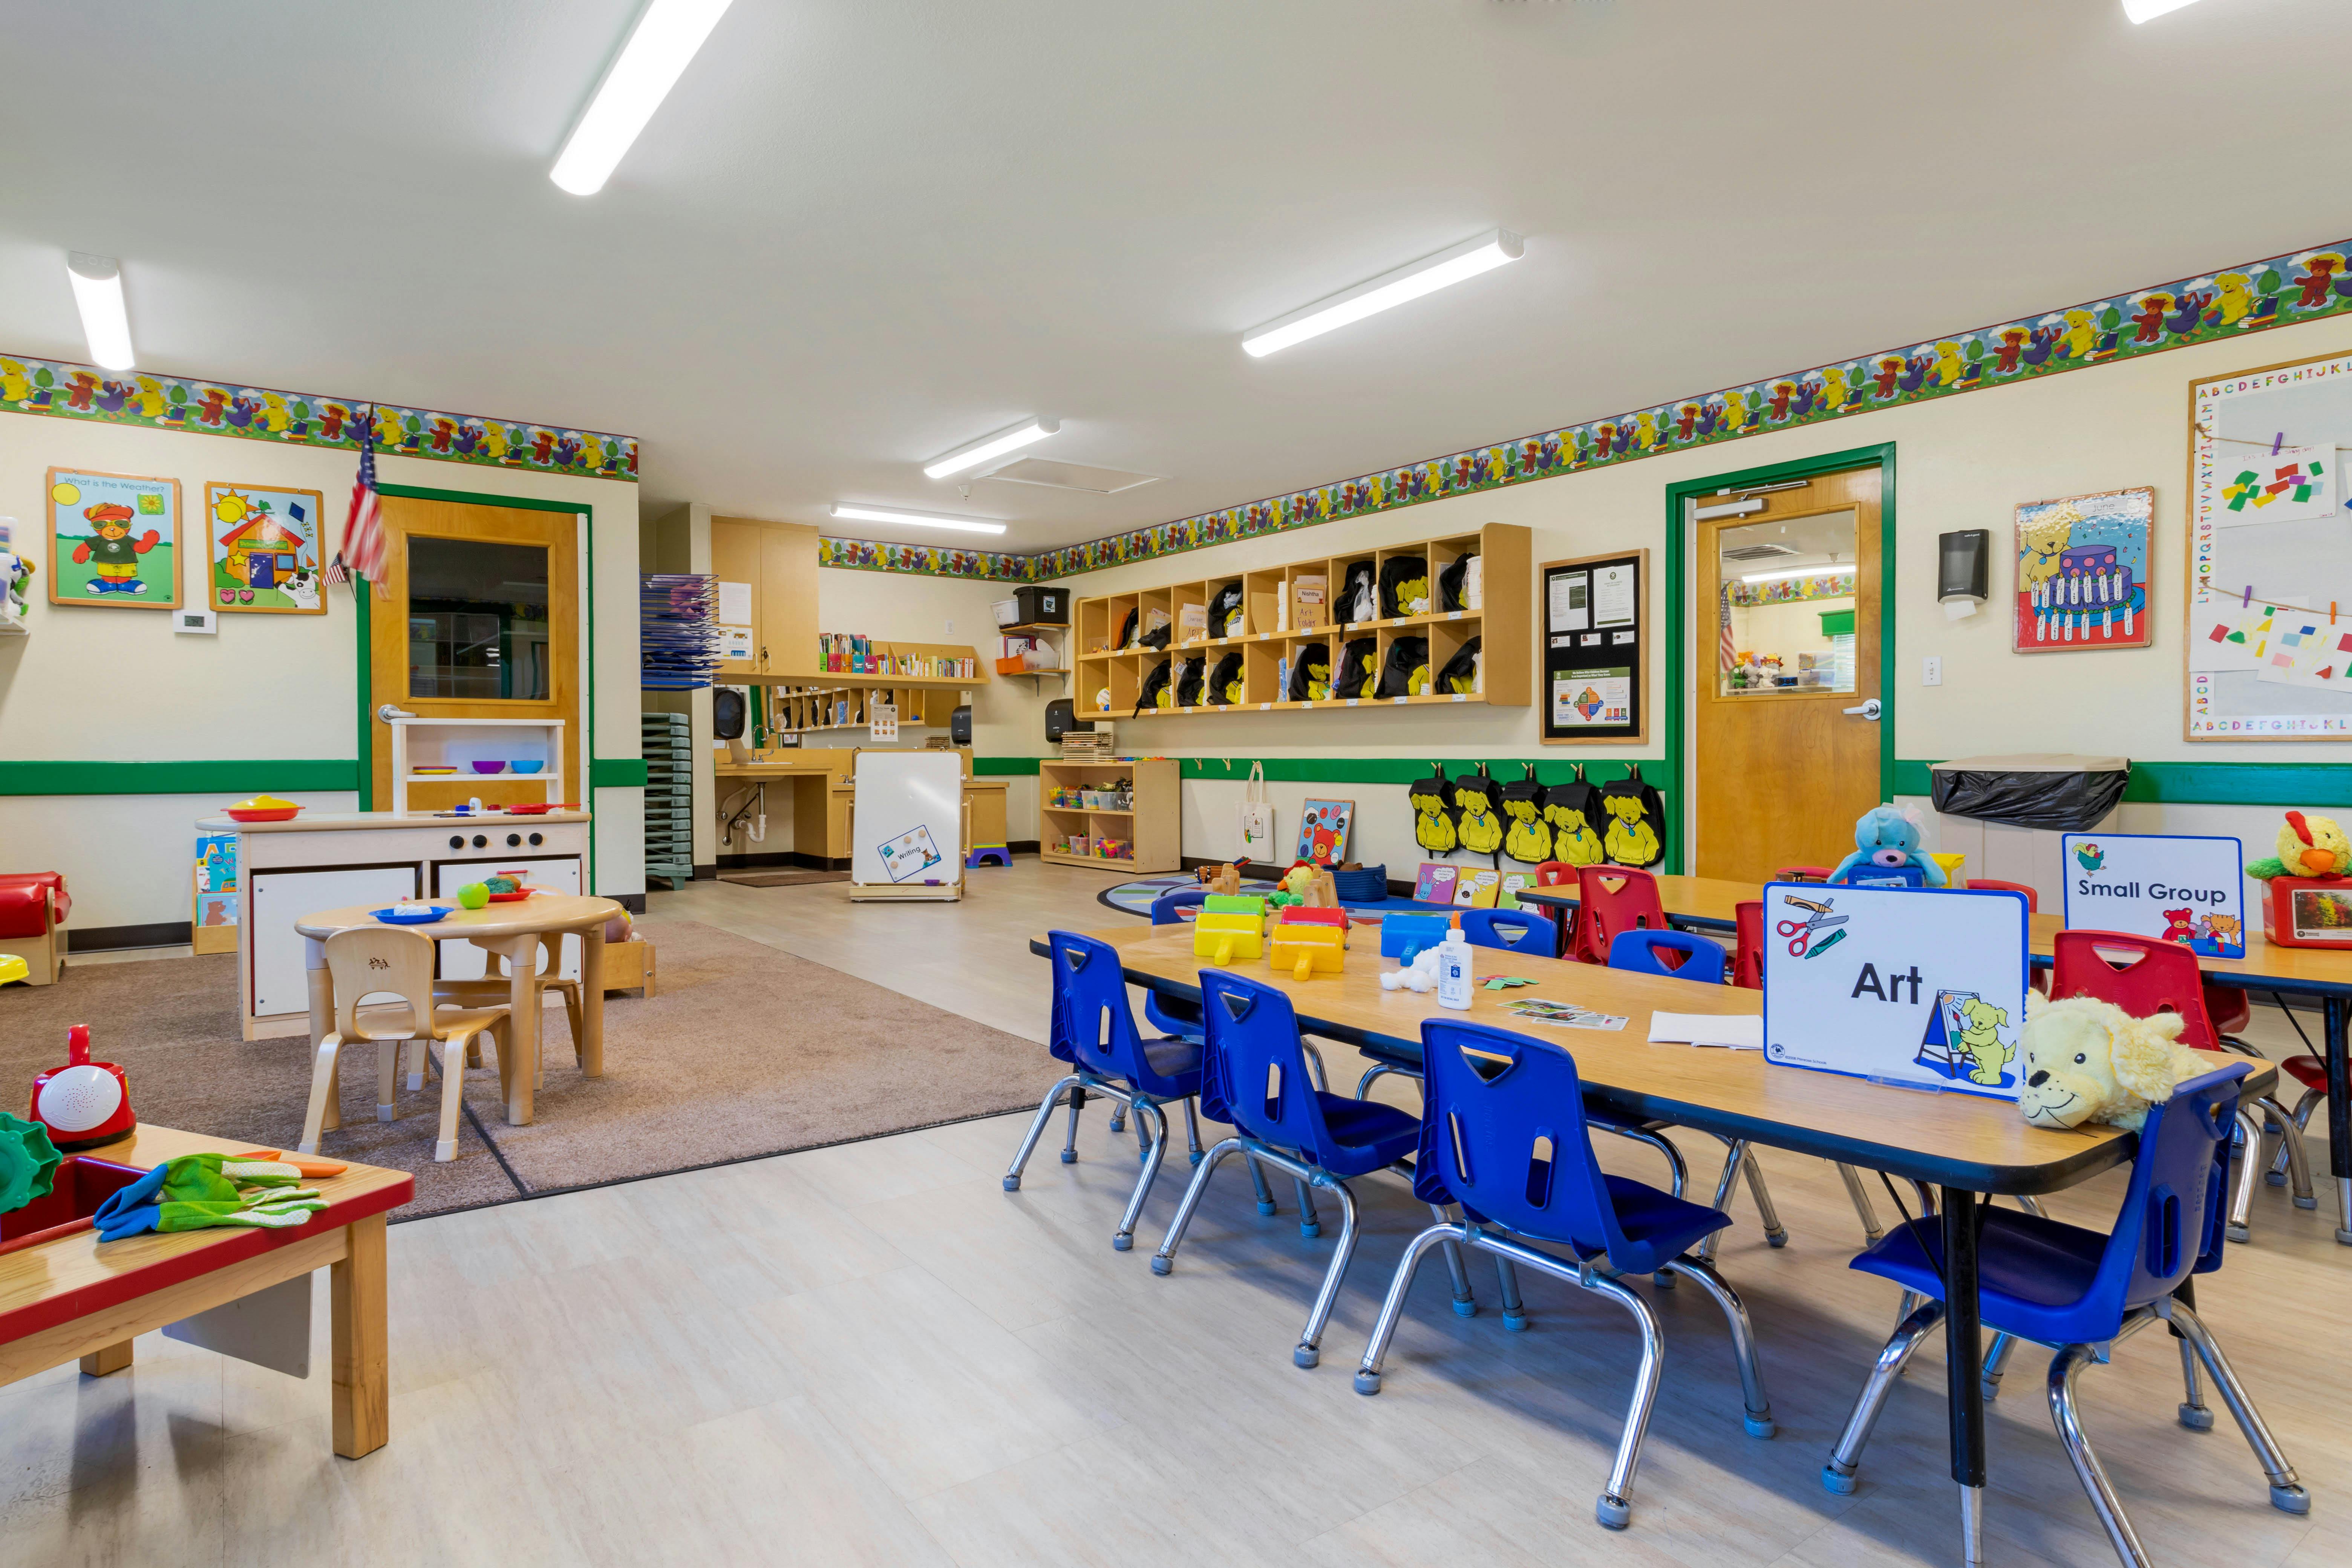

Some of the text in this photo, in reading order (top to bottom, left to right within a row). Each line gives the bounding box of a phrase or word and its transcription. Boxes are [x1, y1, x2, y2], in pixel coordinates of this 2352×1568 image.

[64, 477, 90, 486] What
[120, 482, 165, 492] Weather?
[2093, 504, 2115, 512] June
[1300, 608, 1314, 616] Art
[1297, 617, 1316, 627] Folder
[898, 847, 920, 859] Writing
[2078, 879, 2226, 906] Small Group
[1851, 962, 1923, 1004] Art
